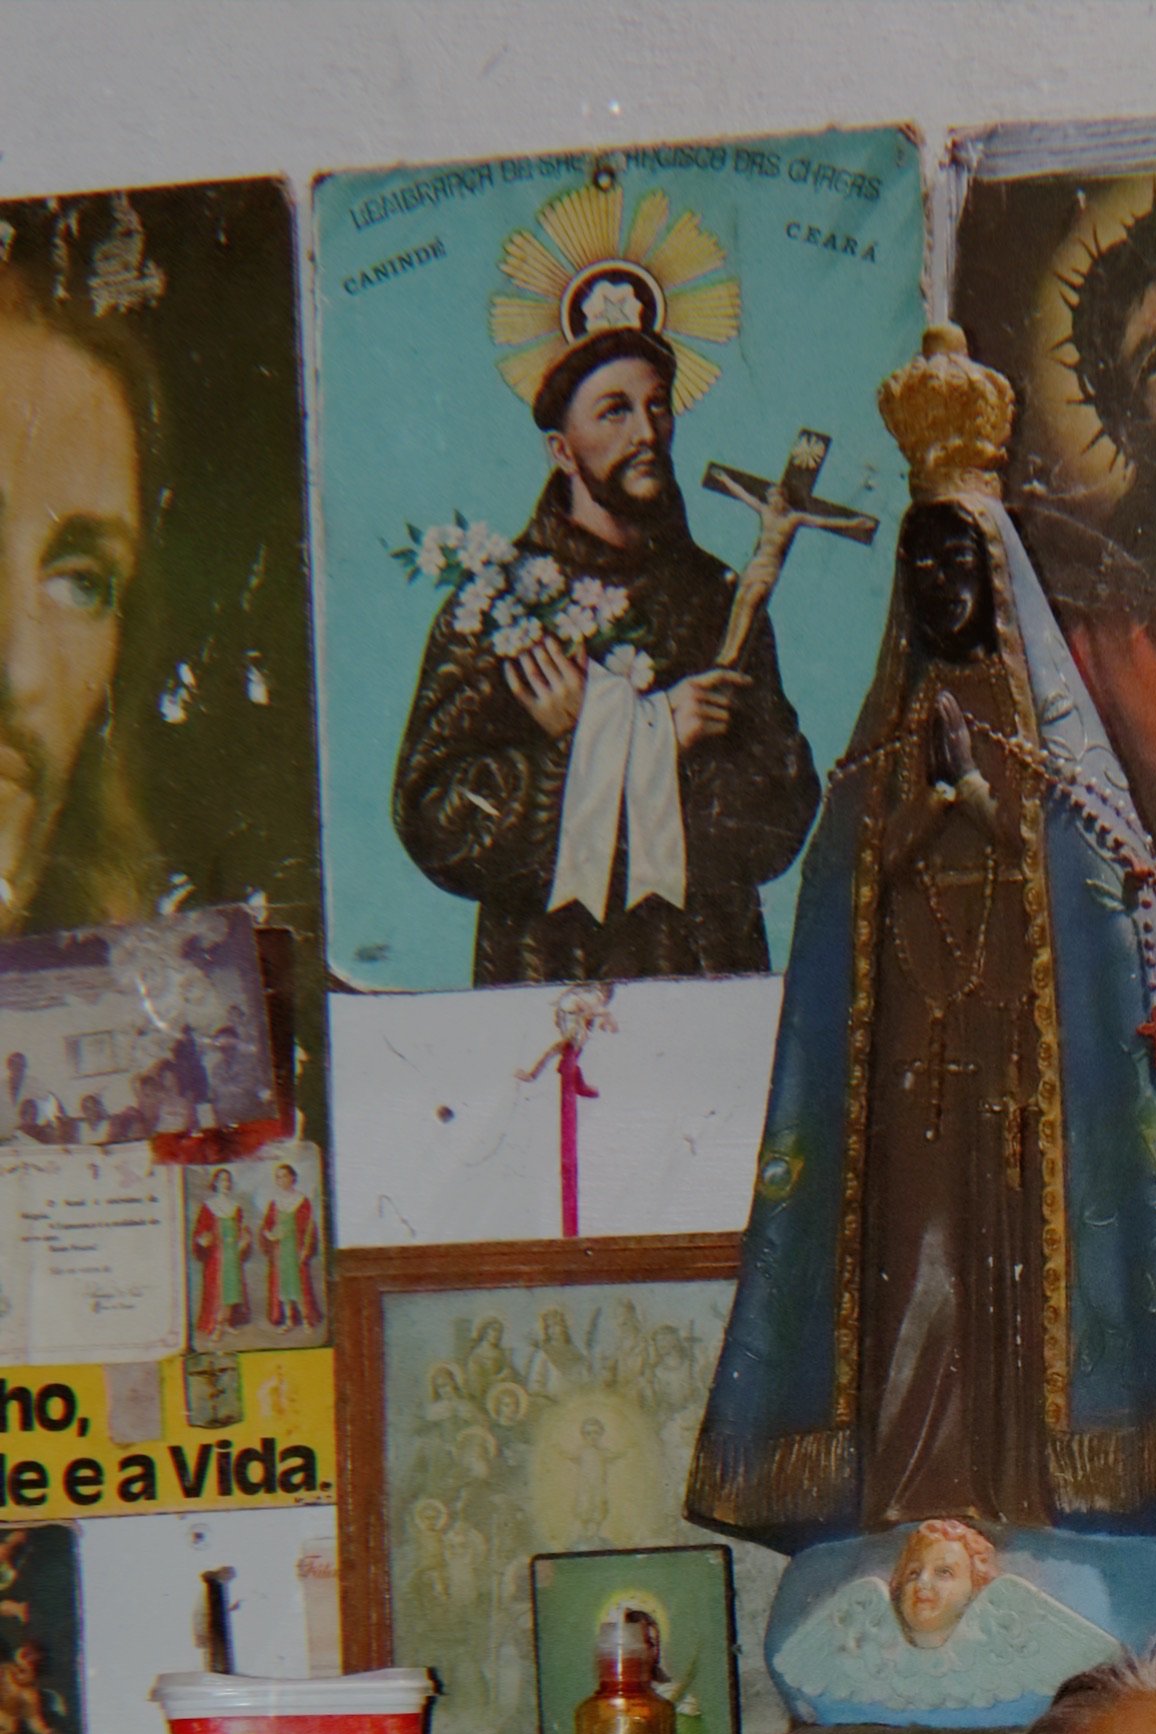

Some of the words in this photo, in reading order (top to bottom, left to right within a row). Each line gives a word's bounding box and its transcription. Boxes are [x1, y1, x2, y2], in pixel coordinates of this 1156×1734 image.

[341, 235, 449, 297] CANINDÉ
[785, 220, 878, 263] CEARÁ
[63, 1457, 105, 1506] e
[117, 1453, 158, 1503] a
[168, 1437, 333, 1499] Vida.
